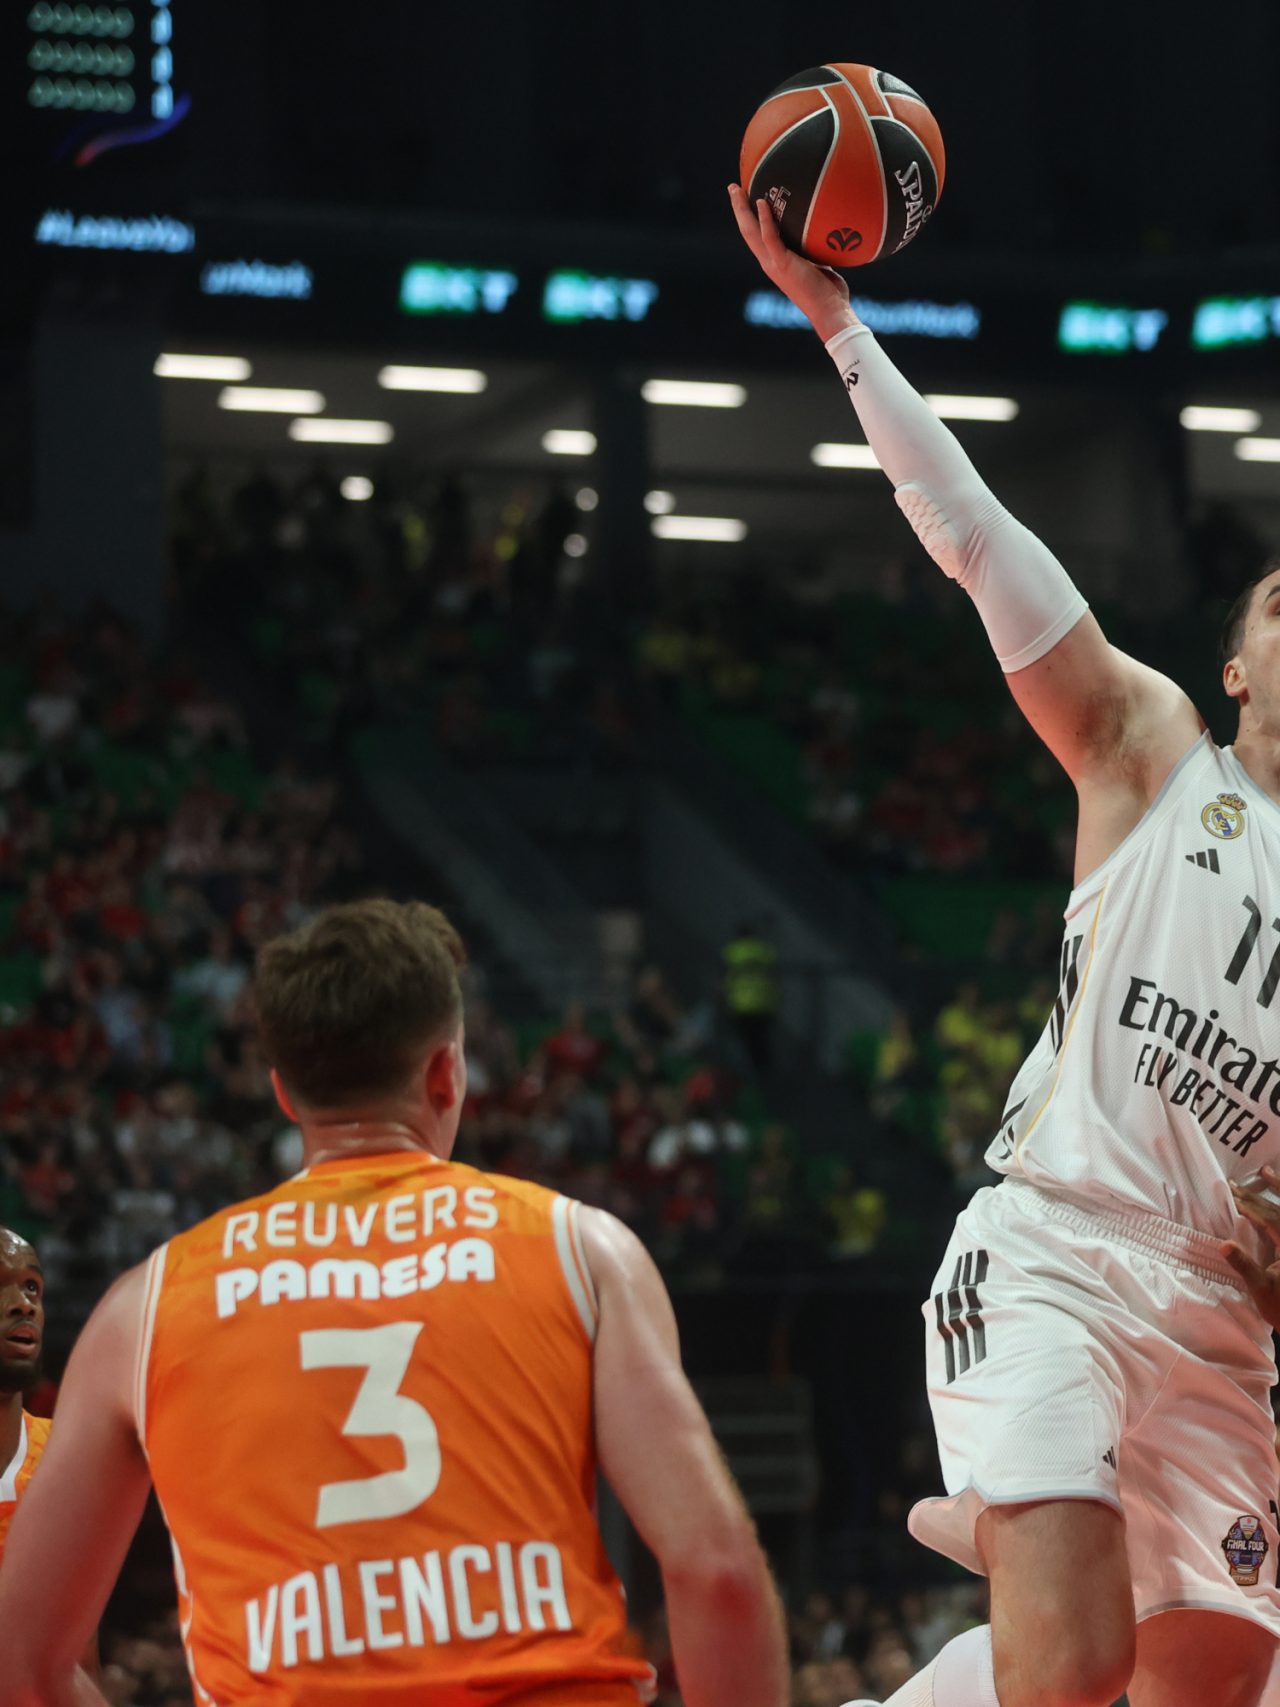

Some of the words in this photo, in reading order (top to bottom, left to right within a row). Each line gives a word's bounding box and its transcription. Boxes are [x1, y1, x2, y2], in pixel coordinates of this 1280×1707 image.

[1134, 1043, 1177, 1091] FLY
[1169, 1067, 1269, 1158] BETTER
[215, 1237, 496, 1319] PAMESA
[222, 1185, 499, 1259] REUVERS
[299, 1321, 442, 1528] 3
[245, 1540, 572, 1673] VALENCIA
